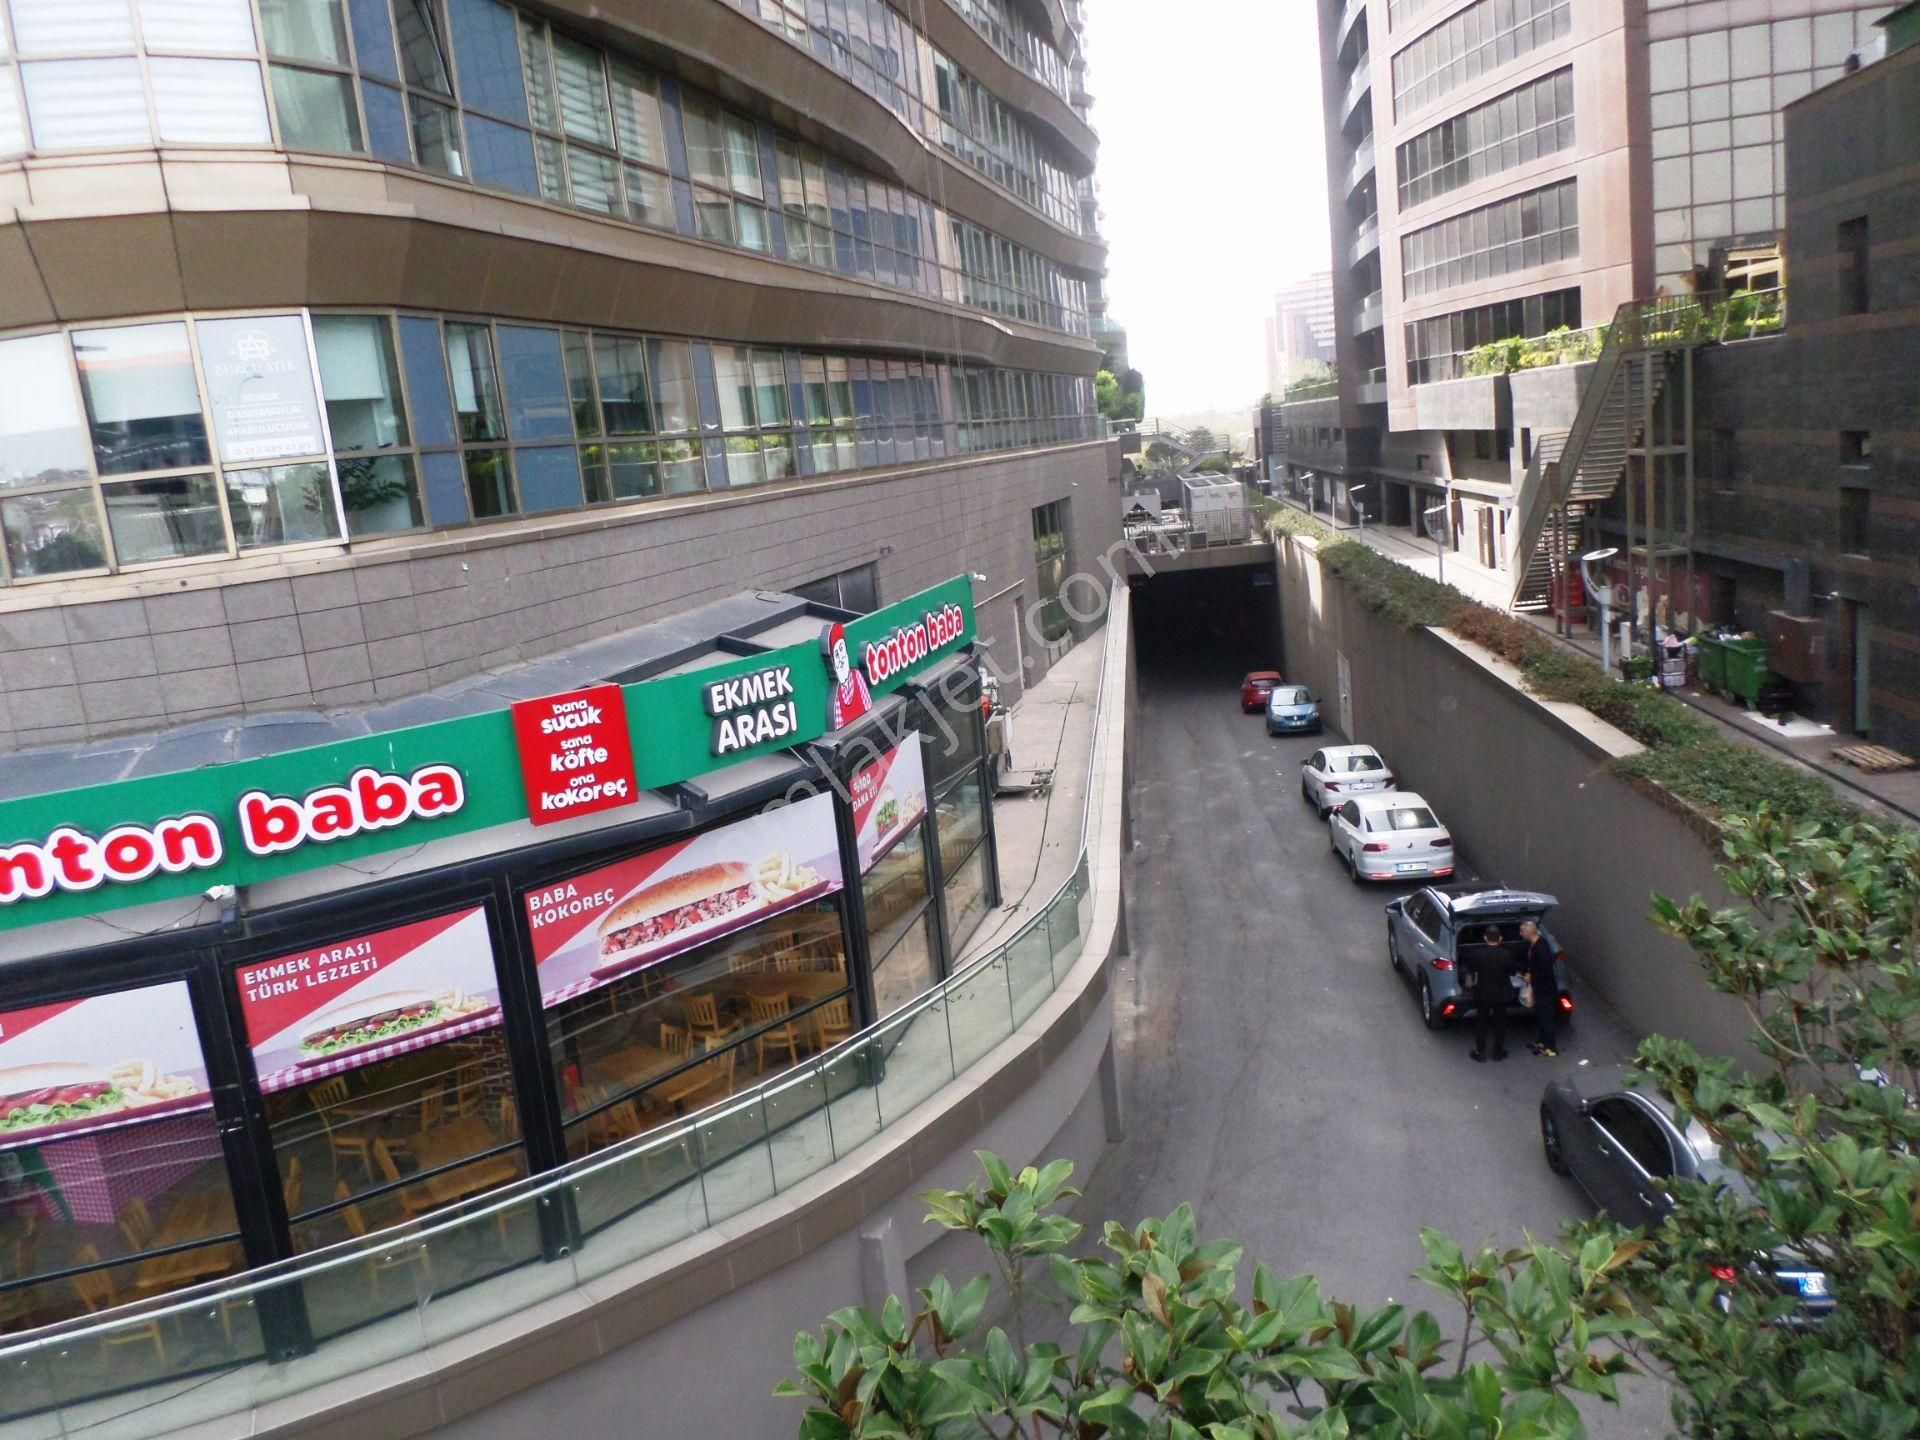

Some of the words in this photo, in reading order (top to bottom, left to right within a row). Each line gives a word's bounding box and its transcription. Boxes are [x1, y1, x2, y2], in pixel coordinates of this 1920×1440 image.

[242, 392, 280, 402] HUKUK
[226, 421, 311, 437] ARABULUCULUK
[866, 623, 928, 685] tonton
[927, 603, 964, 651] baba
[711, 666, 794, 713] EKMEK
[541, 706, 602, 734] sucuk
[552, 699, 588, 715] bana
[560, 734, 592, 749] sana
[718, 701, 797, 754] ARASI
[550, 747, 608, 771] köfte
[541, 778, 628, 810] kokoreç
[569, 773, 595, 787] ona
[238, 763, 465, 855] baba
[852, 790, 869, 812] DANA
[529, 883, 578, 911] BABA
[532, 888, 615, 929] KOKOREÇ
[243, 957, 311, 985] EKMEK
[318, 941, 372, 967] ARASI
[247, 978, 299, 1002] TÜRK
[305, 956, 378, 987] LEZZETİ
